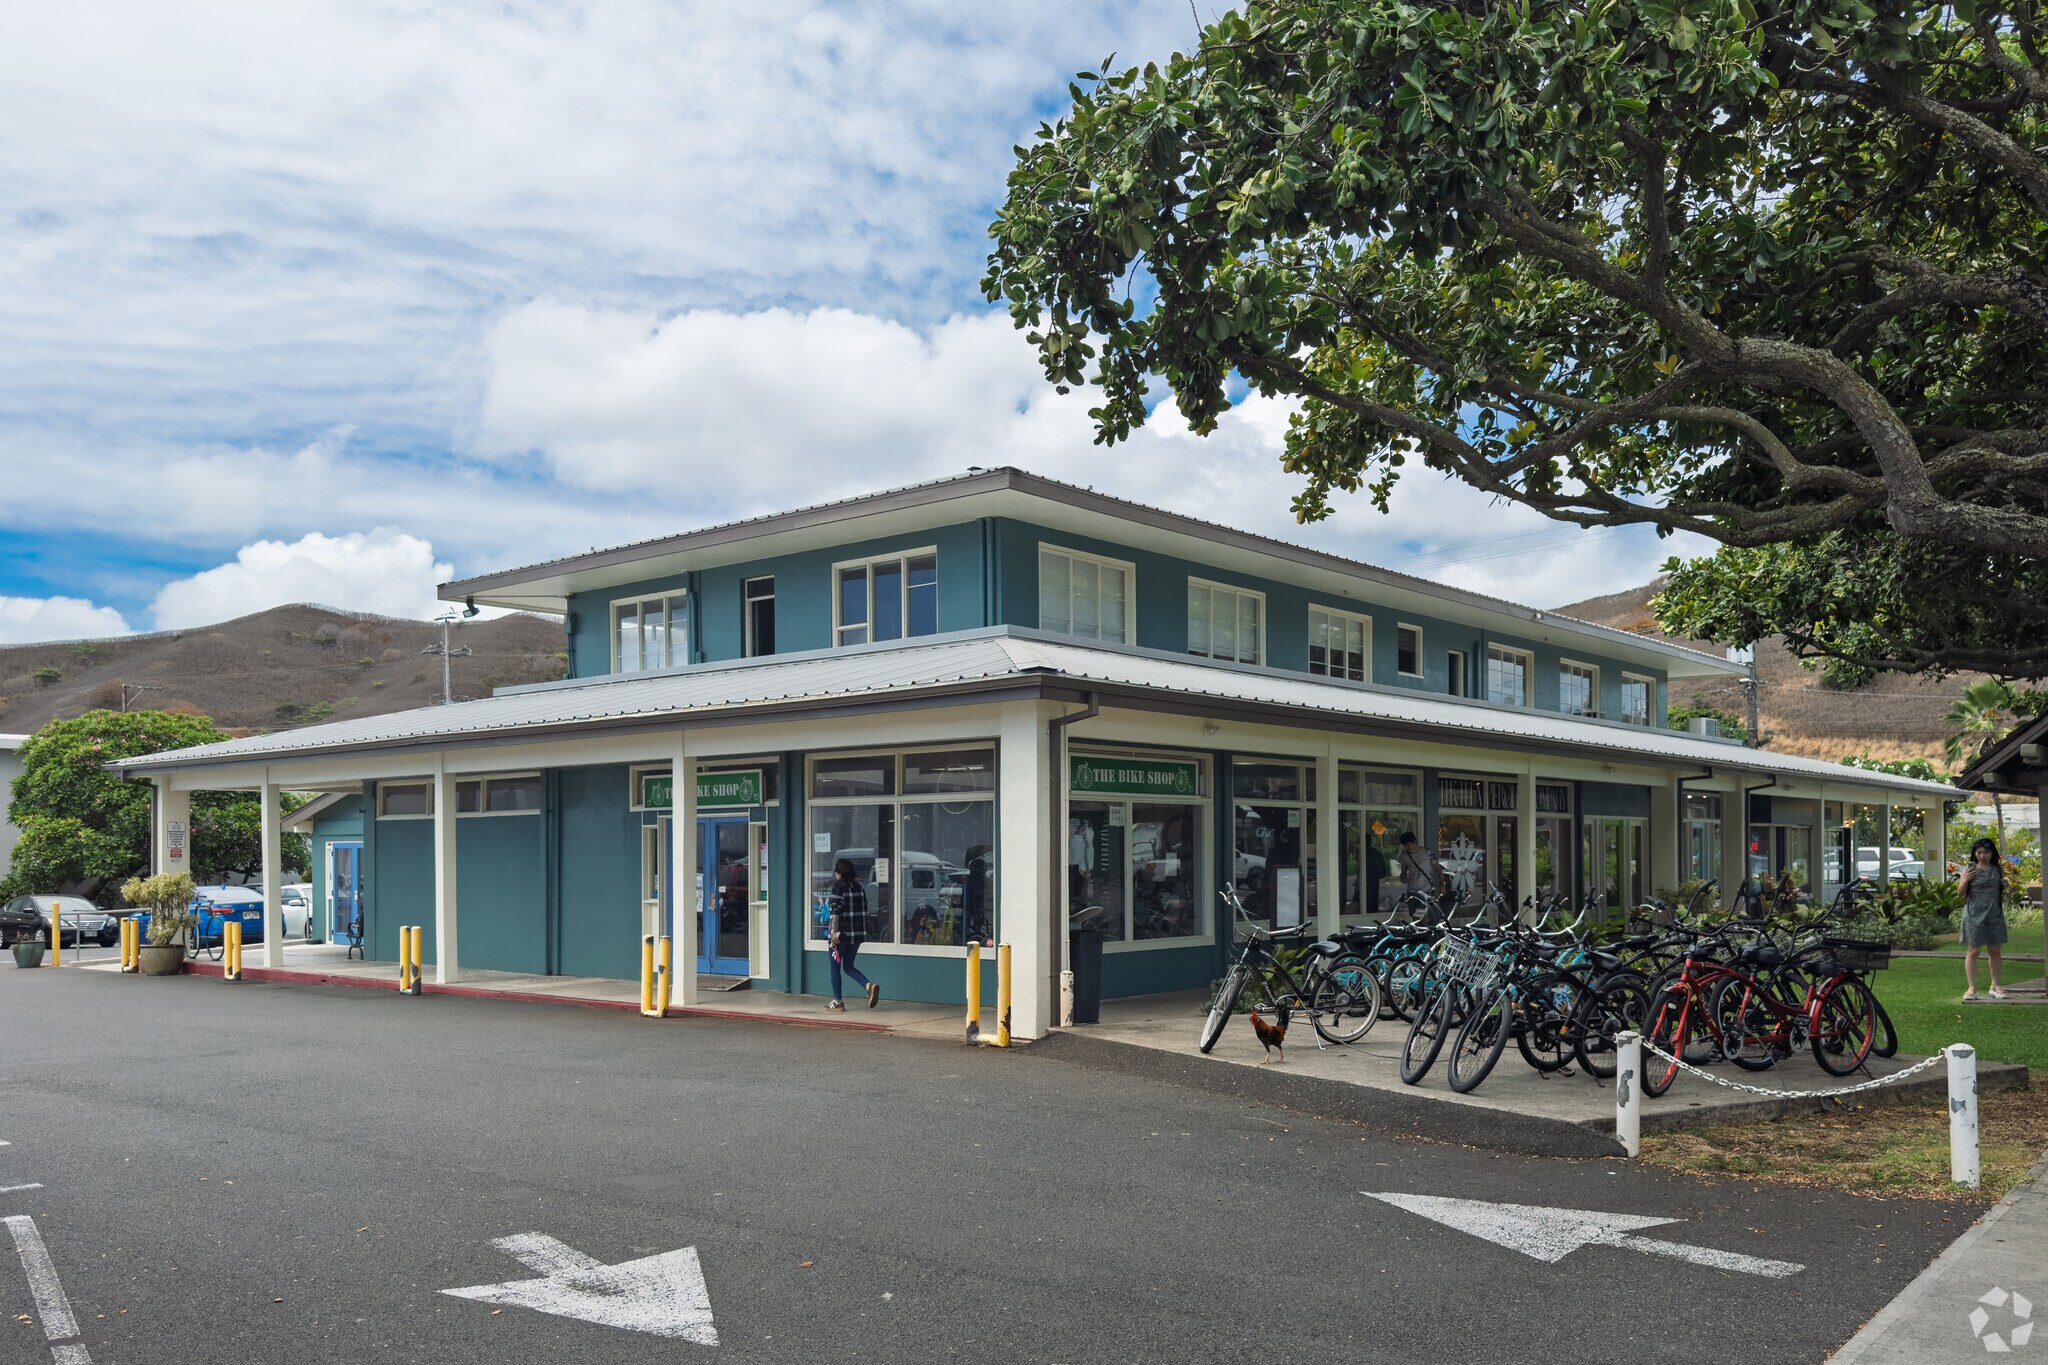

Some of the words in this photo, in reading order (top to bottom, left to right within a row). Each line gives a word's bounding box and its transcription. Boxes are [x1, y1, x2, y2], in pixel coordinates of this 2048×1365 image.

[1093, 769, 1116, 782] THE
[1118, 770, 1145, 784] BIKE
[1148, 771, 1175, 785] SHOP
[712, 783, 739, 797] SHOP
